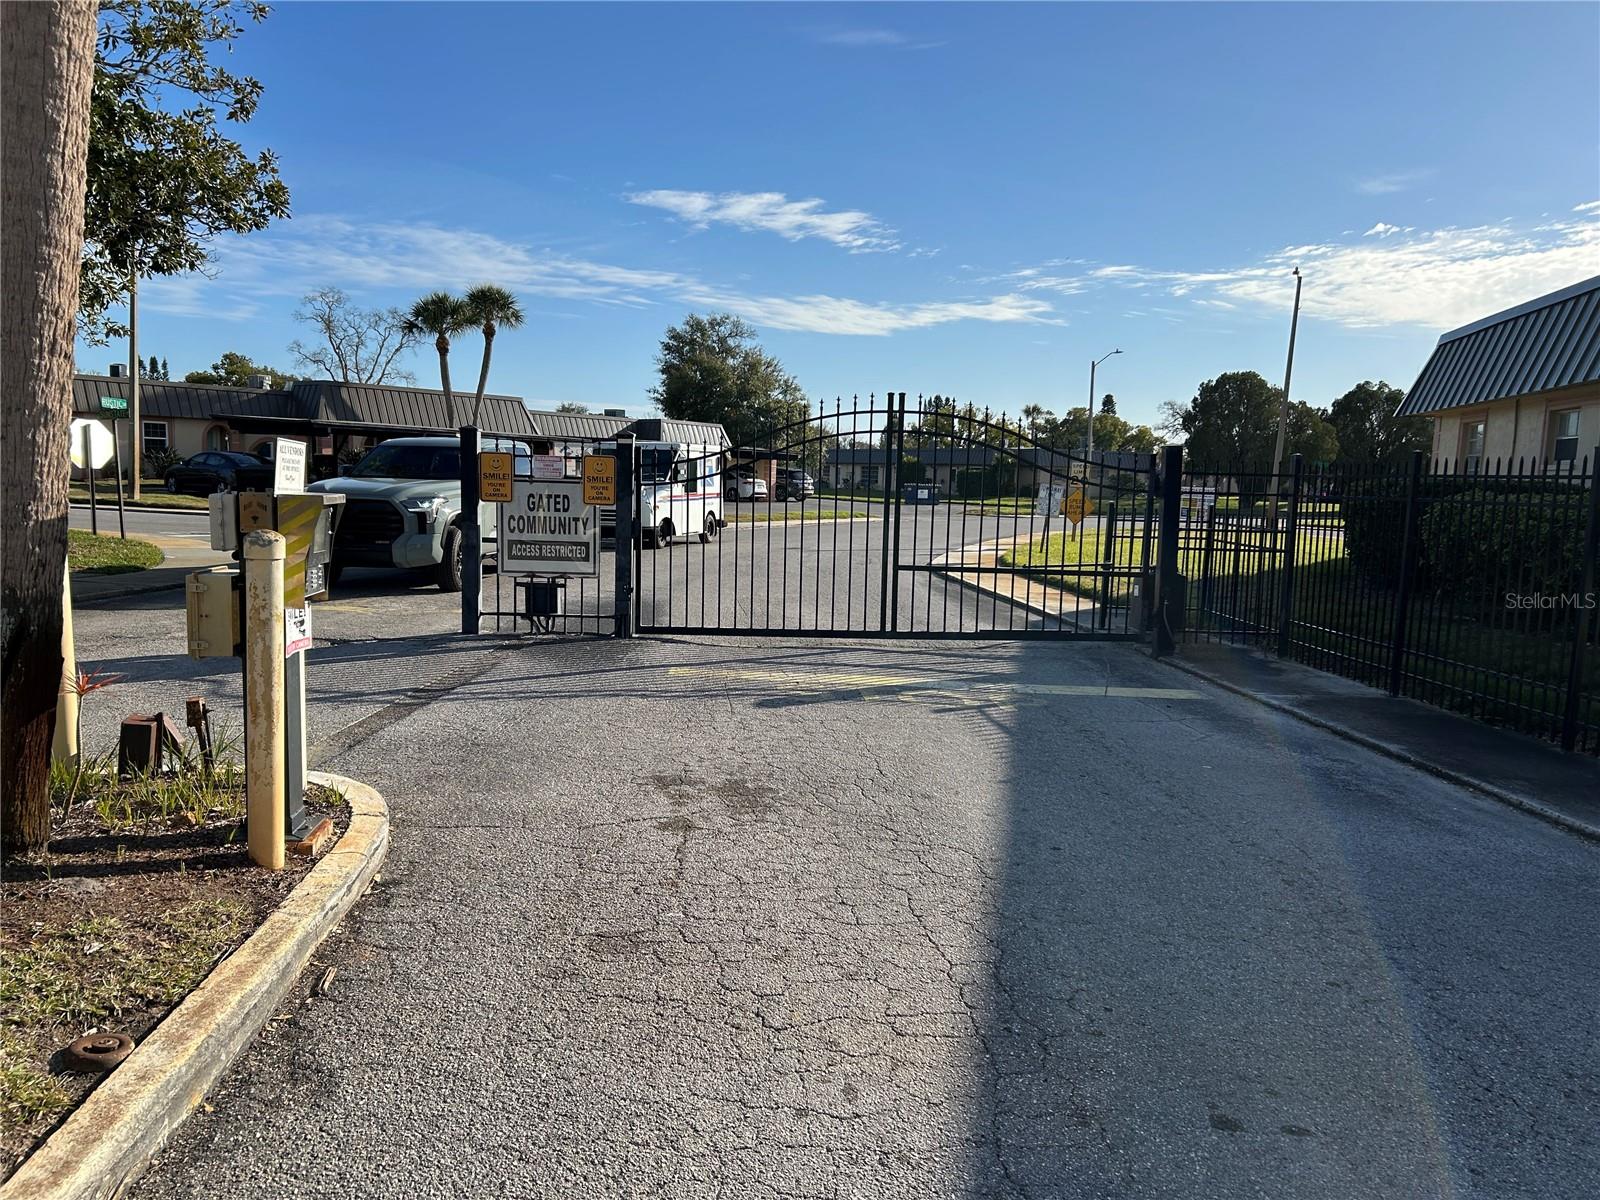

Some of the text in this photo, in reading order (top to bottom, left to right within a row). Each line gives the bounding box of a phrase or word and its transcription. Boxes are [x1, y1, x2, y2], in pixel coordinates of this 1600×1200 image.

[482, 472, 510, 480] SMILE!
[586, 475, 613, 484] SMILE!
[527, 493, 570, 513] GATED
[507, 514, 590, 536] COMMUNITY
[511, 543, 586, 558] ACCESS RESTRICTED
